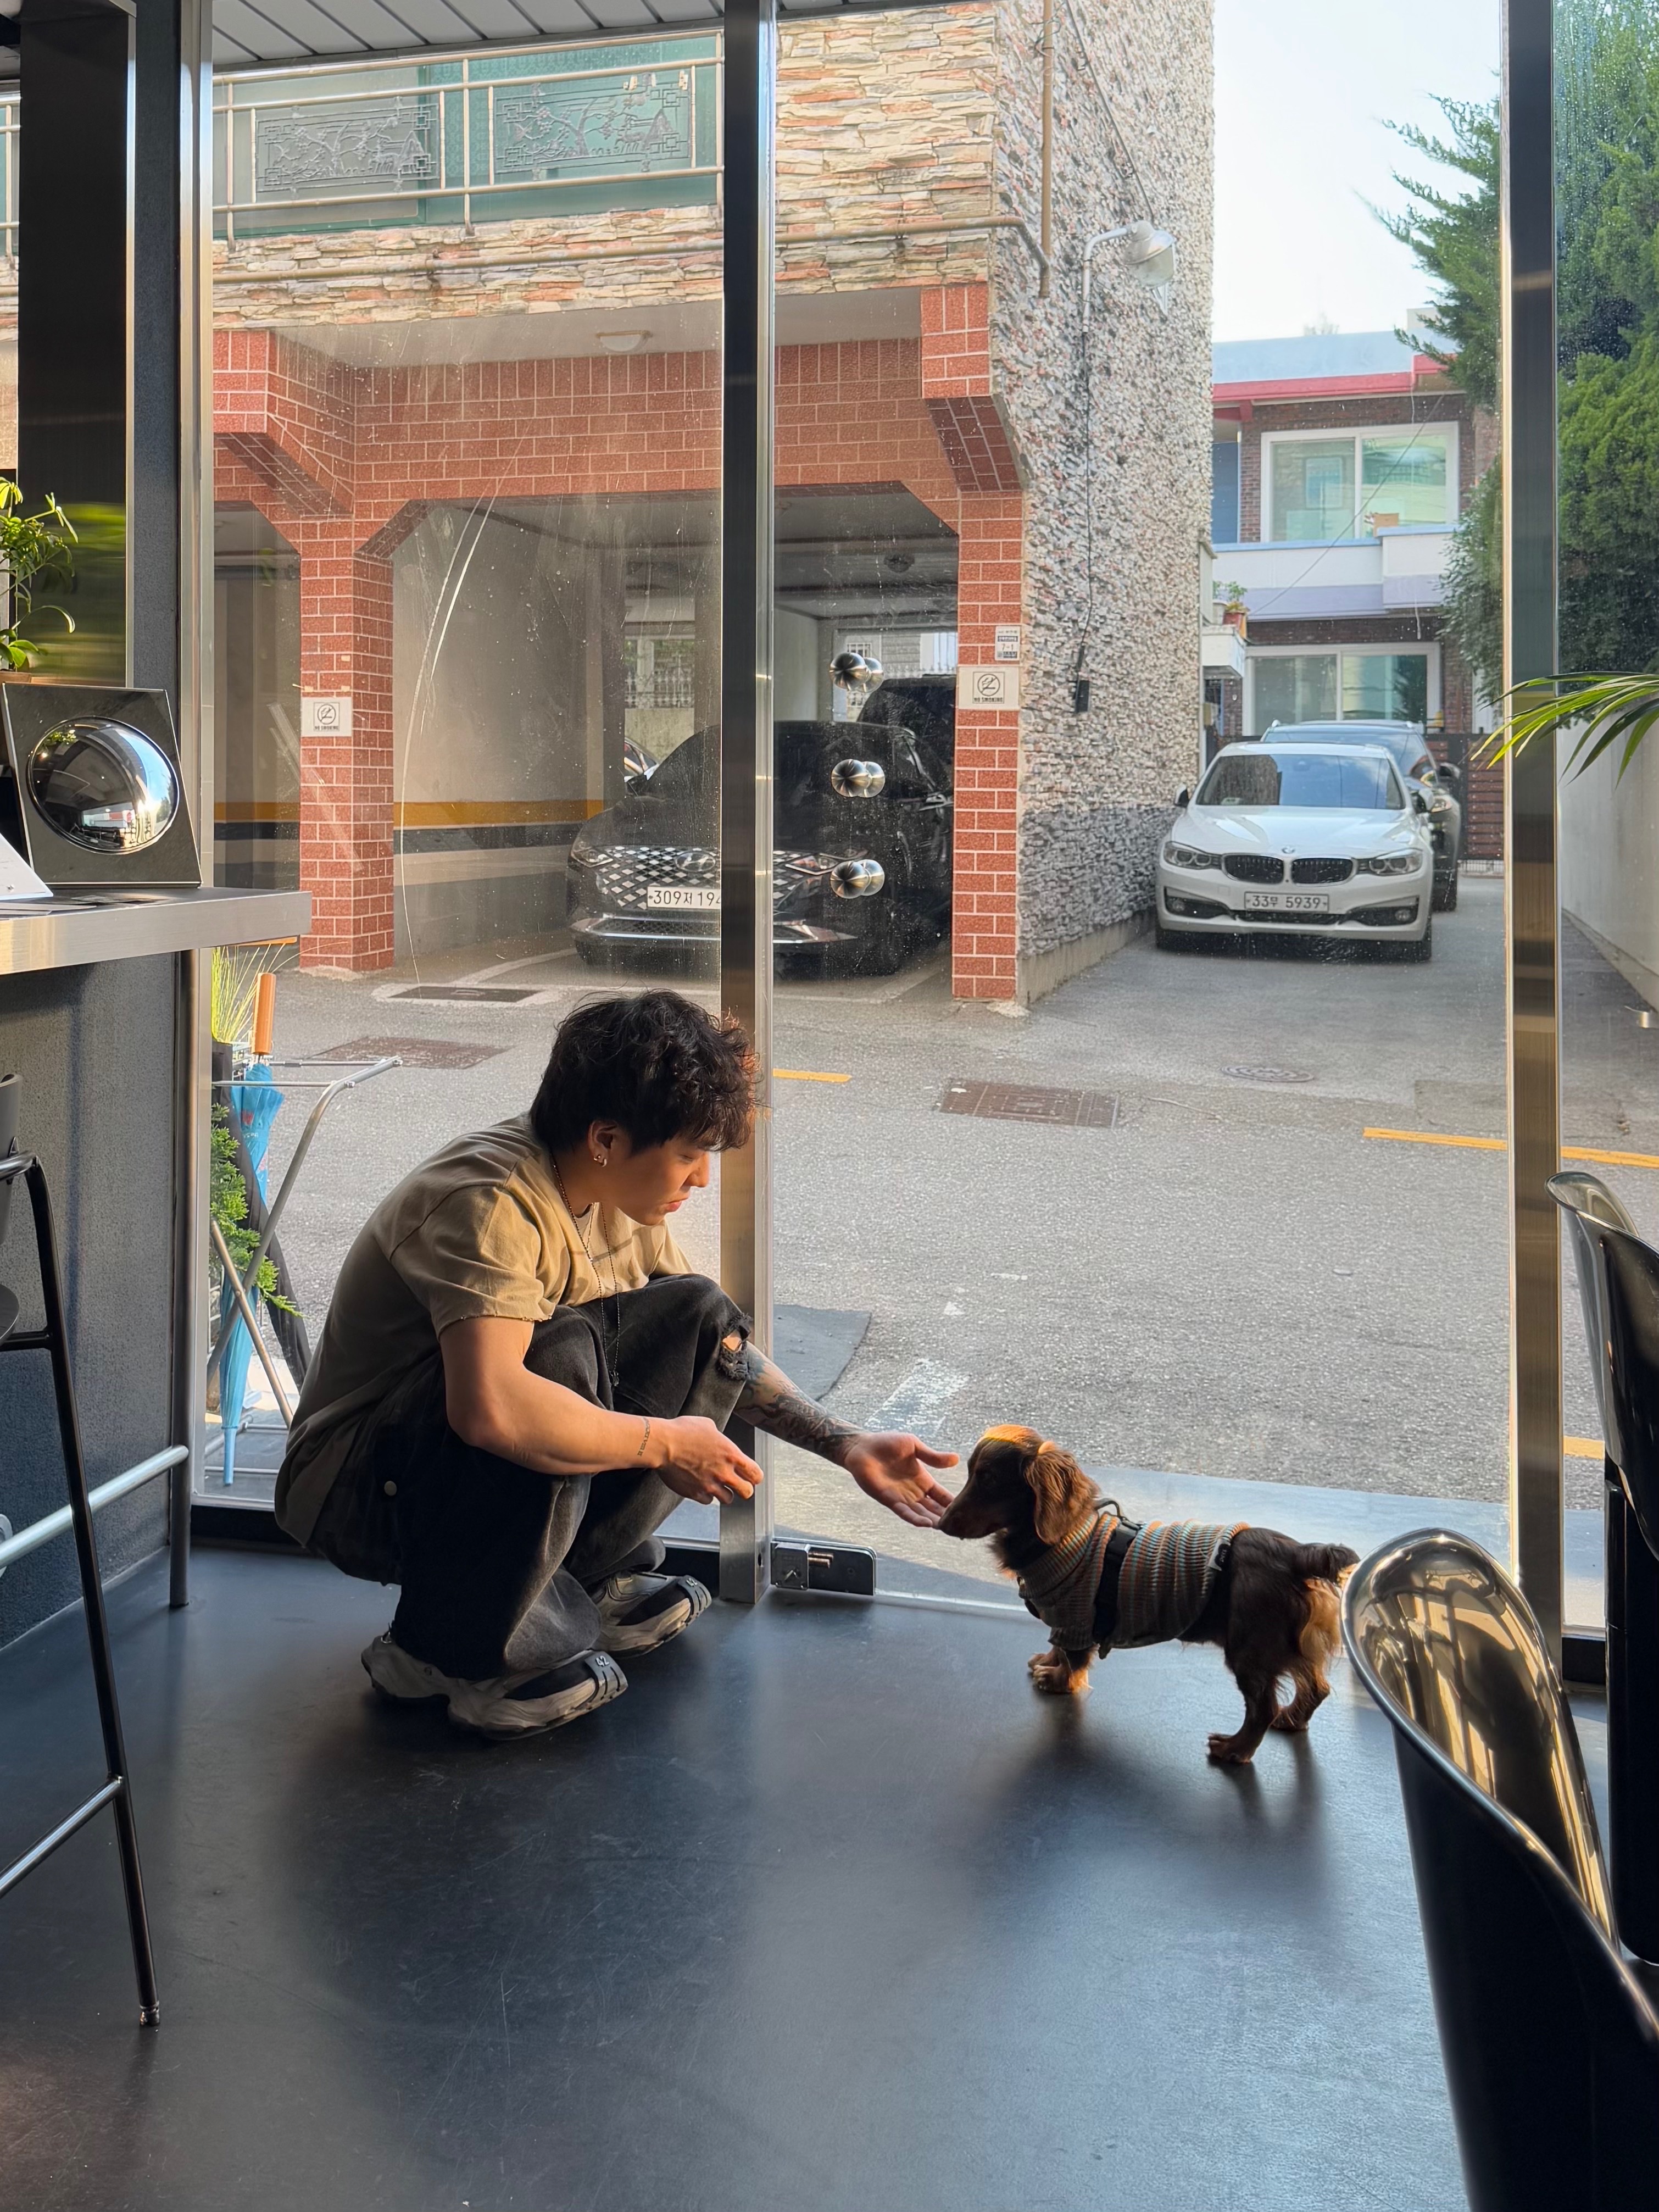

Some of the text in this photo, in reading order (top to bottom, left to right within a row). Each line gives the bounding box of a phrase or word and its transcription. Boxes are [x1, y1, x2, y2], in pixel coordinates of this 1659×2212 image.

[653, 890, 692, 905] 309저
[1285, 896, 1321, 909] 5939
[595, 1655, 610, 1667] 42
